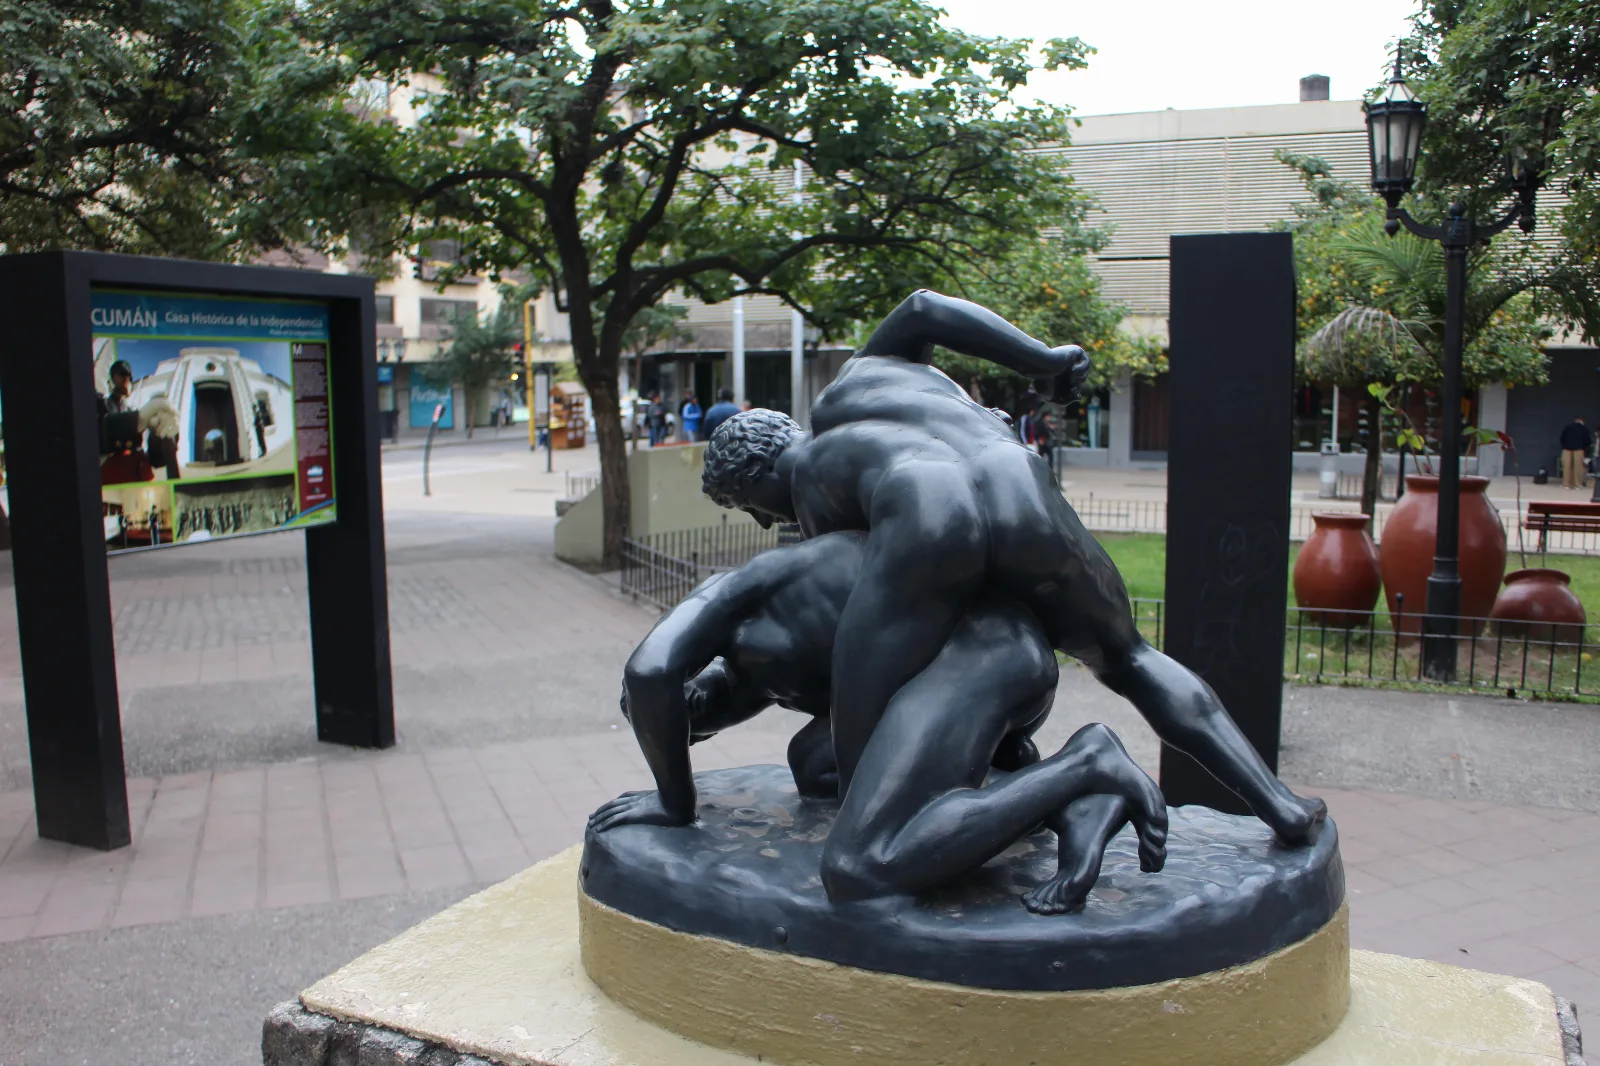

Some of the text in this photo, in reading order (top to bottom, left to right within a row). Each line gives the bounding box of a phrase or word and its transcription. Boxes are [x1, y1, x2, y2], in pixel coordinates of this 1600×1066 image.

[90, 306, 157, 328] CUMÁN
[165, 311, 323, 330] Casa Histórica de la Independencia
